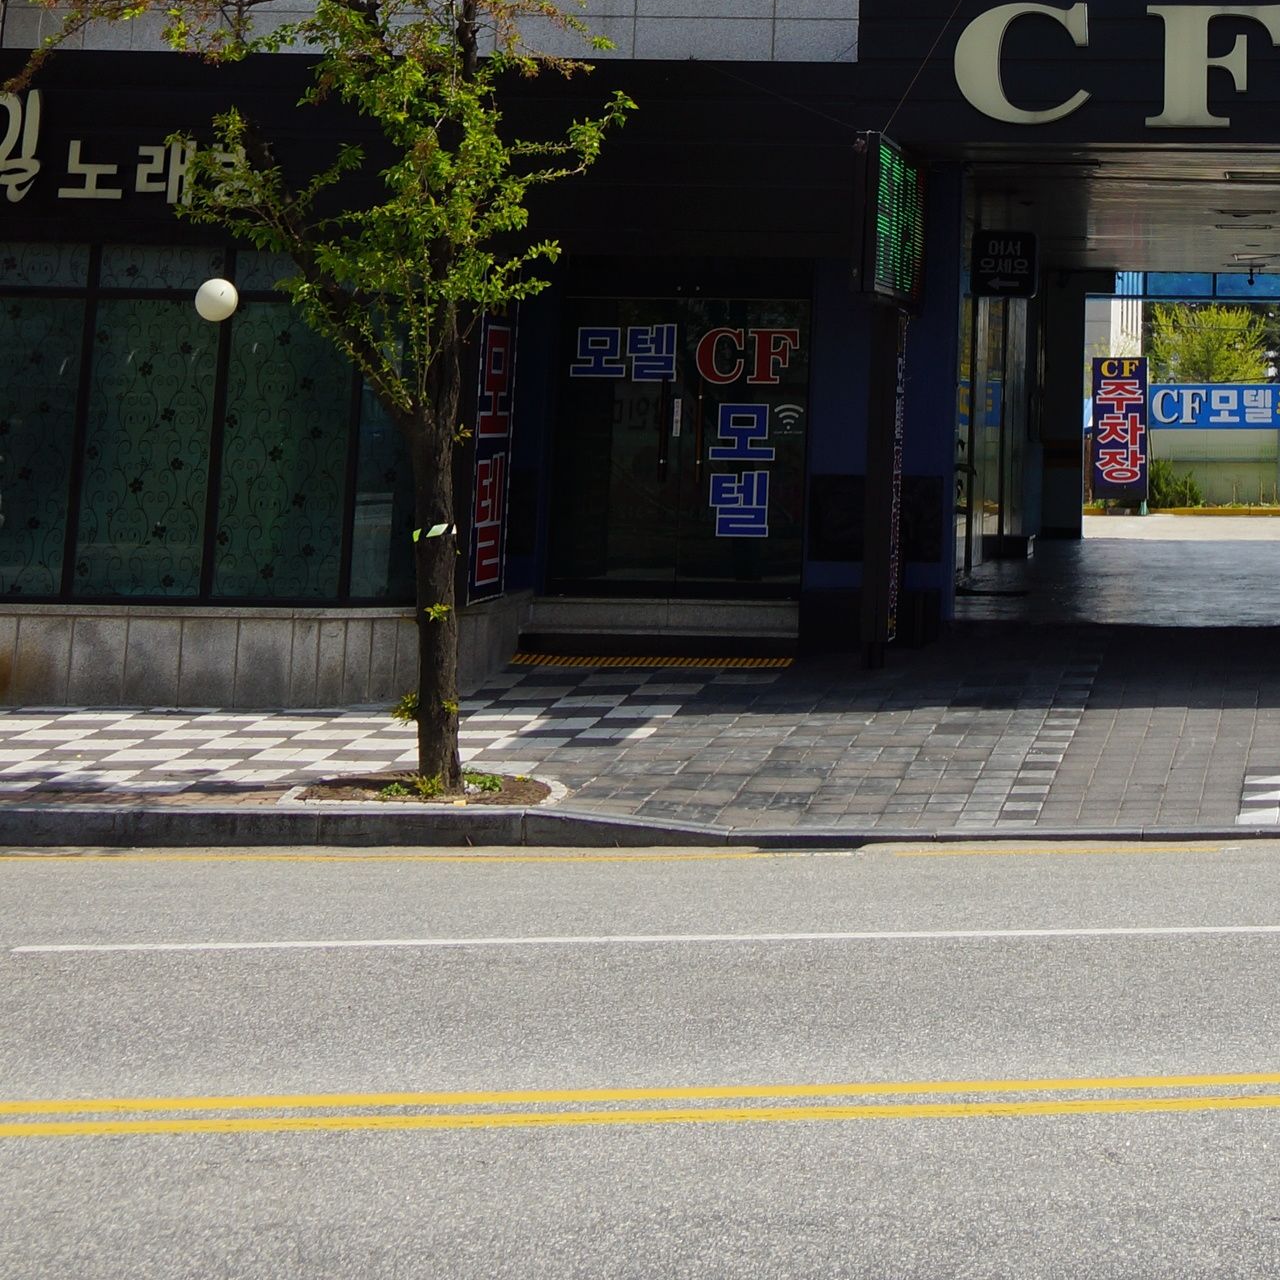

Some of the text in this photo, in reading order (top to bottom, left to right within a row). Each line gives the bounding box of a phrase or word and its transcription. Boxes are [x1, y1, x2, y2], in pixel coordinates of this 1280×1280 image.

[979, 258, 1029, 274] 오세요
[988, 240, 1021, 256] 어서
[570, 323, 677, 382] 모텔
[695, 327, 800, 384] CF
[1100, 359, 1139, 378] CF
[474, 325, 511, 587] 모텔
[1096, 379, 1145, 484] 주차장
[709, 403, 775, 538] 모텔
